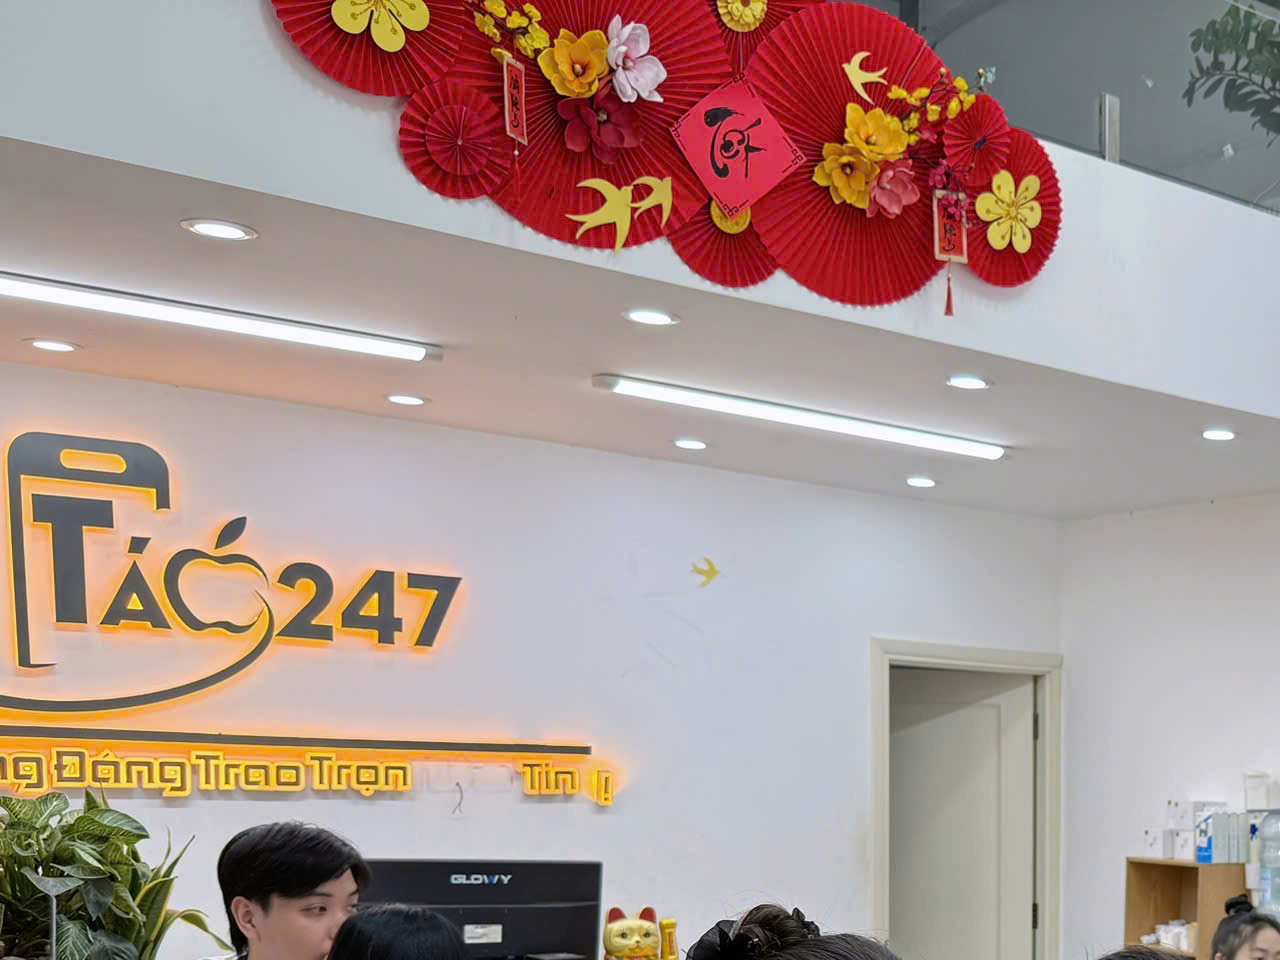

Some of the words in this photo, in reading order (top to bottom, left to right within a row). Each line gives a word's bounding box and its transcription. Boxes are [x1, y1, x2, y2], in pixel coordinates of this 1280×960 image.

[191, 750, 304, 792] Trao
[304, 752, 413, 797] Trọn
[450, 874, 512, 885] GLOWY
